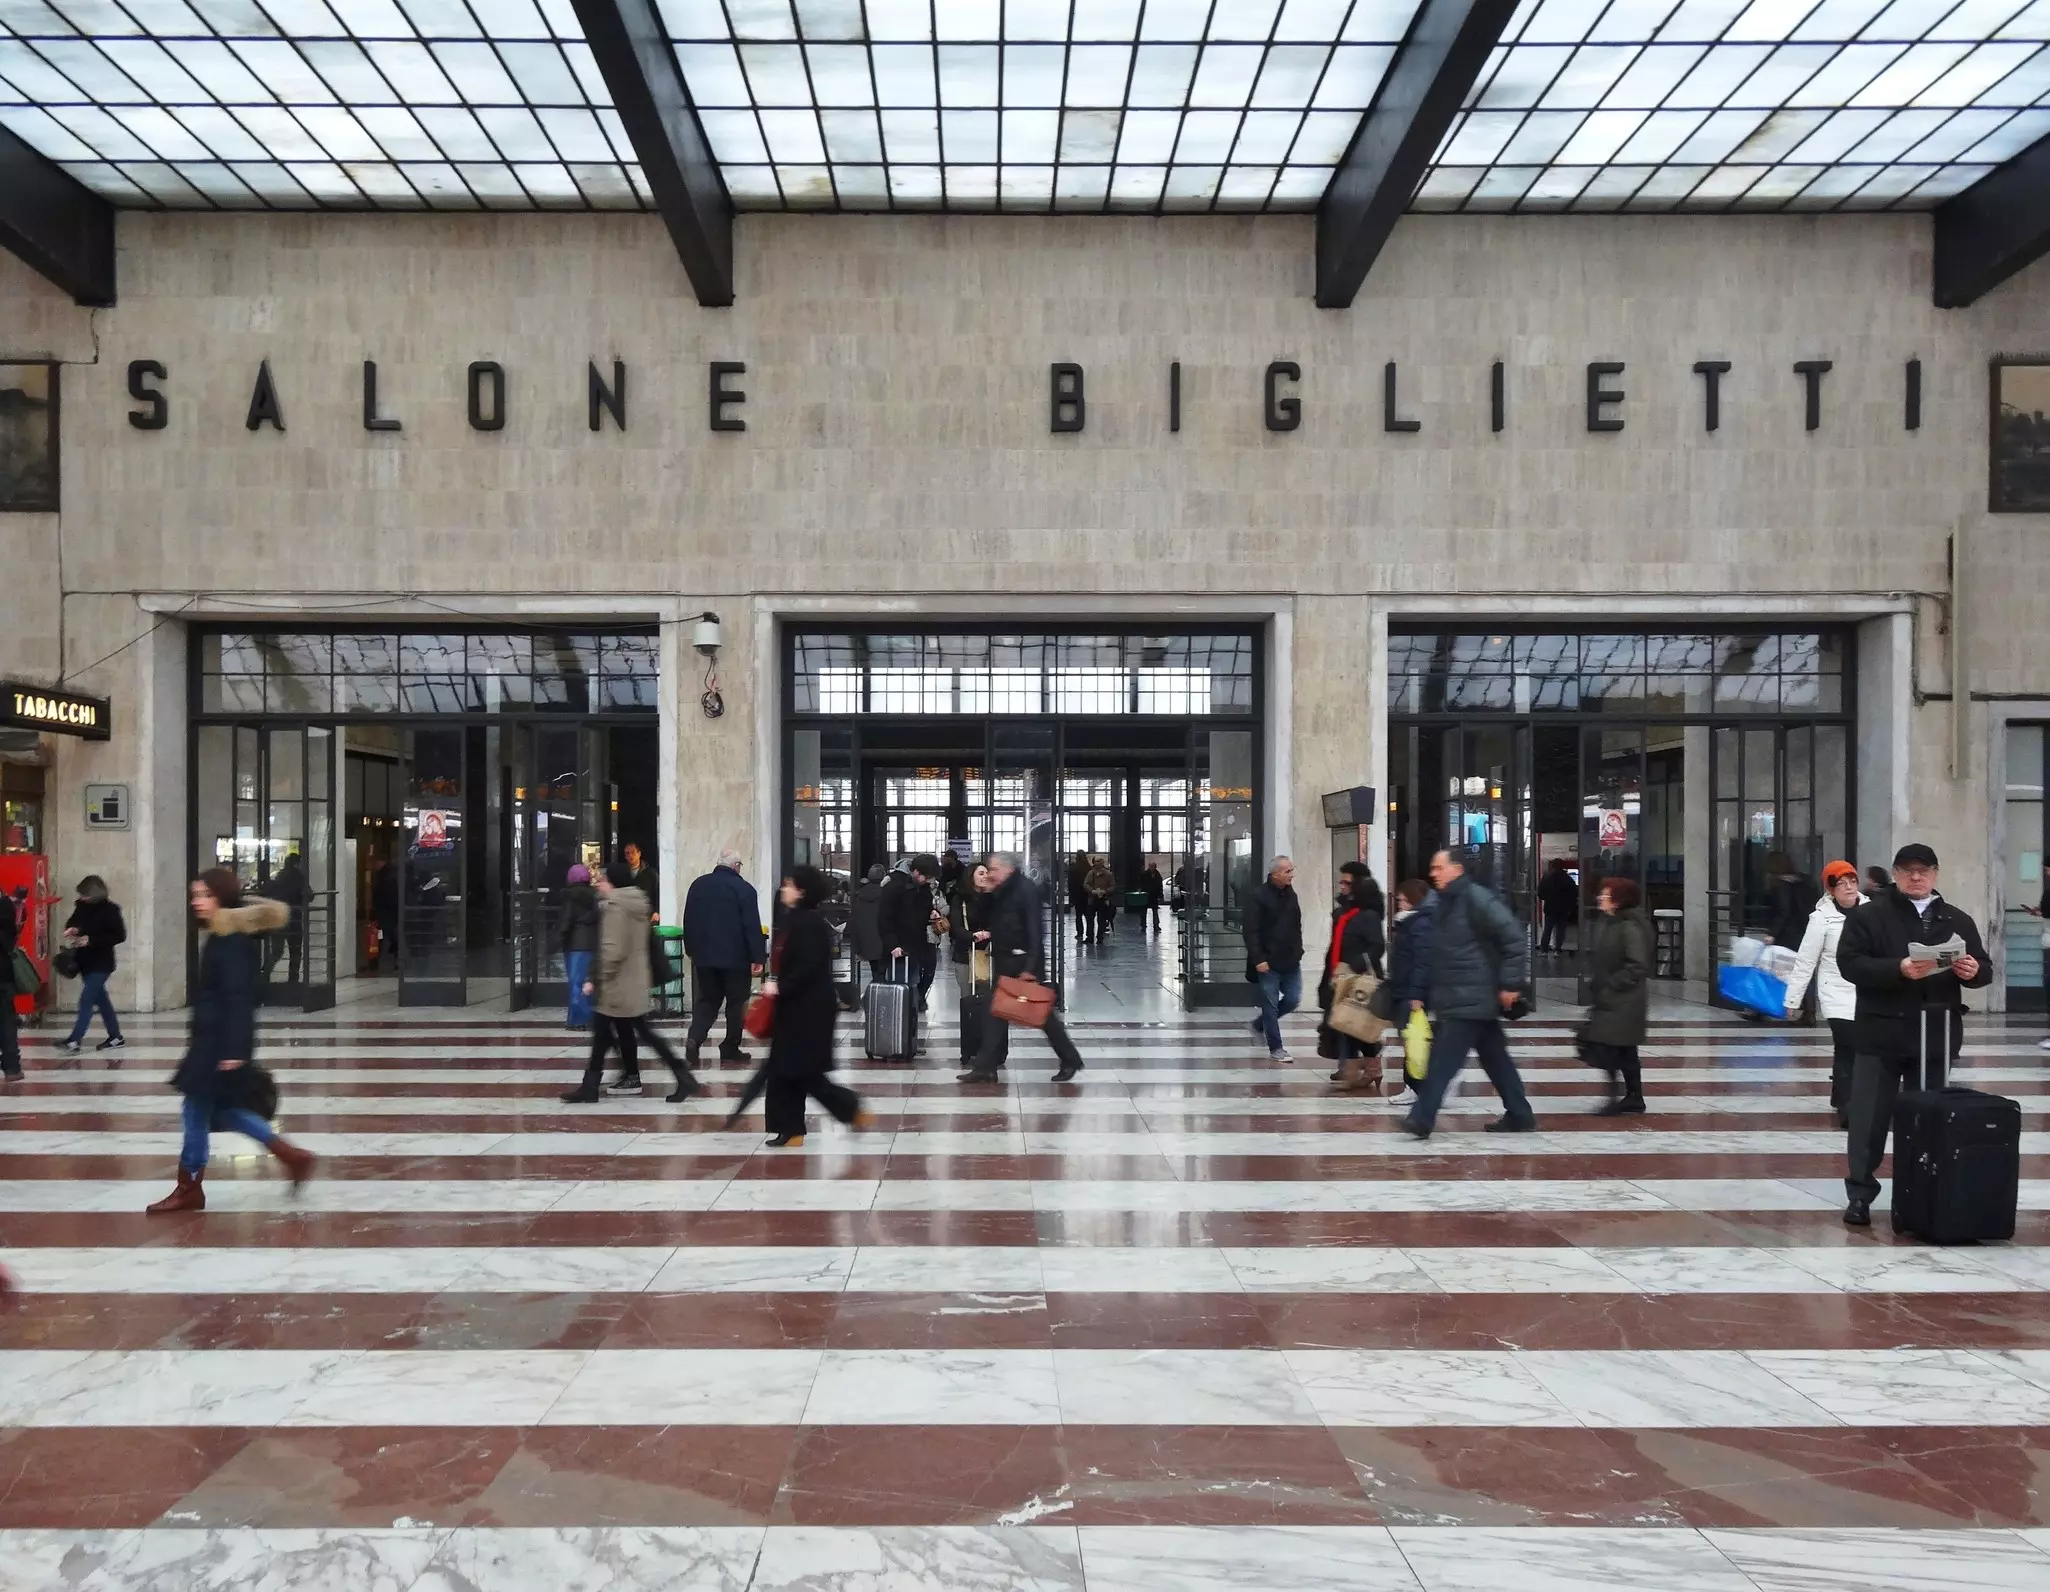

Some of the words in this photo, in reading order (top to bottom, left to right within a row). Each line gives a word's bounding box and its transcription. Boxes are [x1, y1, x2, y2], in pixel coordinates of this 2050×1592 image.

[127, 359, 747, 433] SALONE
[1050, 359, 1922, 434] BIGLIETTI
[14, 693, 96, 726] TABACCHI
